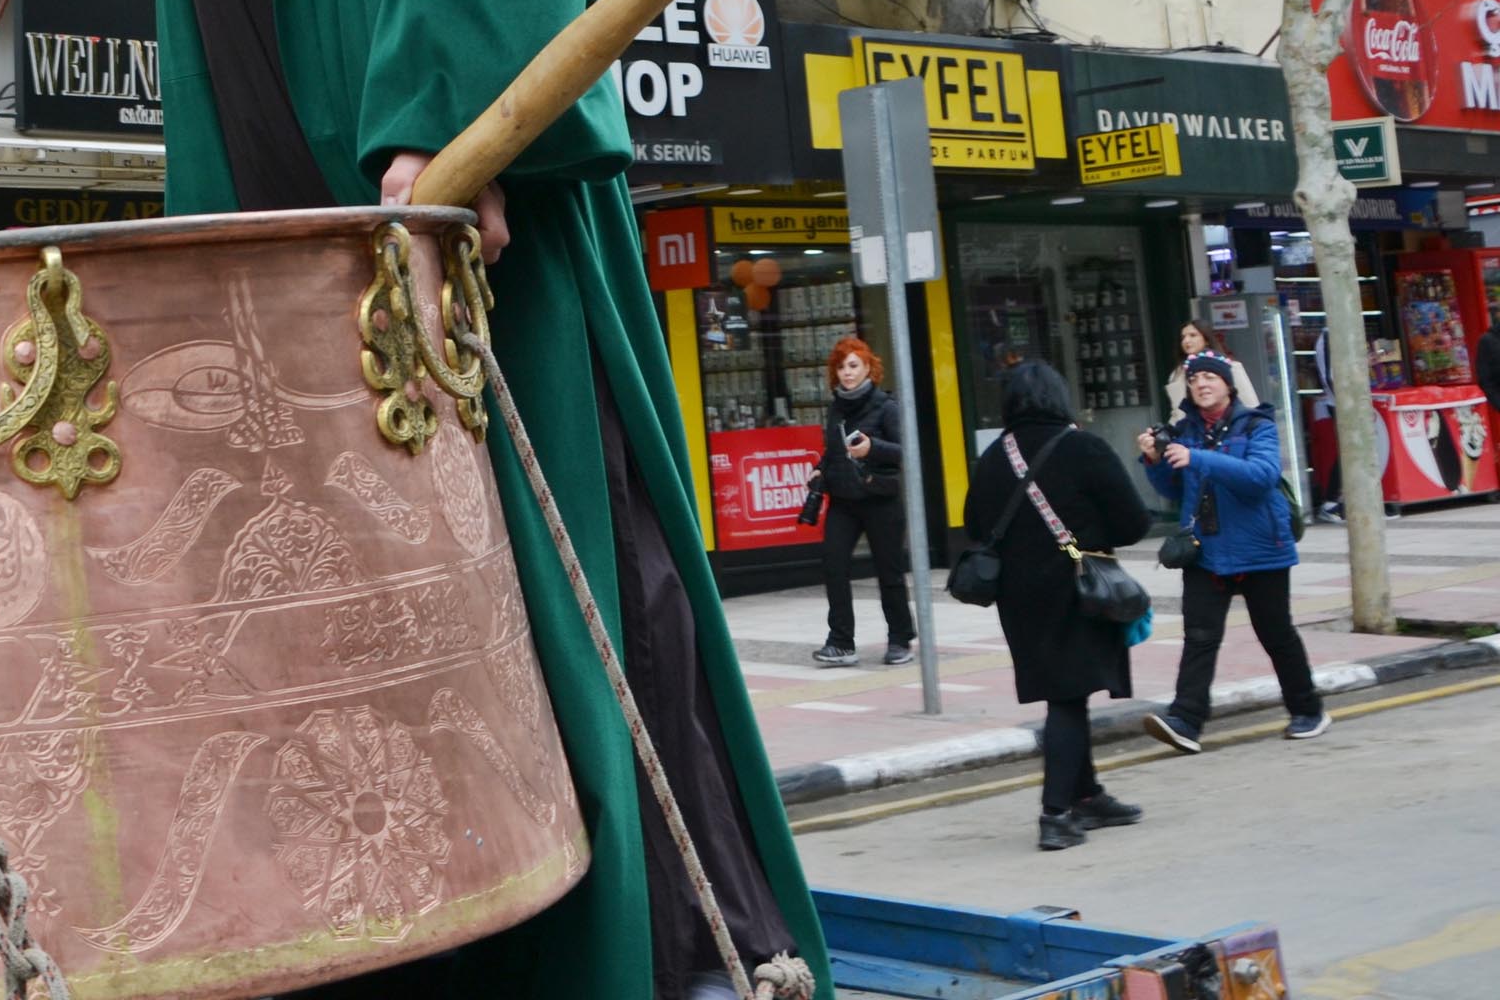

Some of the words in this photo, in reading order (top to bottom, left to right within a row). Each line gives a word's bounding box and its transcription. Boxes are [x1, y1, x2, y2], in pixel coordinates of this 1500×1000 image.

[712, 48, 768, 65] HUAWEI
[652, 140, 712, 162] SERVİS
[966, 147, 1029, 161] PARFUM
[1080, 129, 1161, 166] EYFEL
[729, 211, 766, 232] her
[772, 216, 796, 230] an
